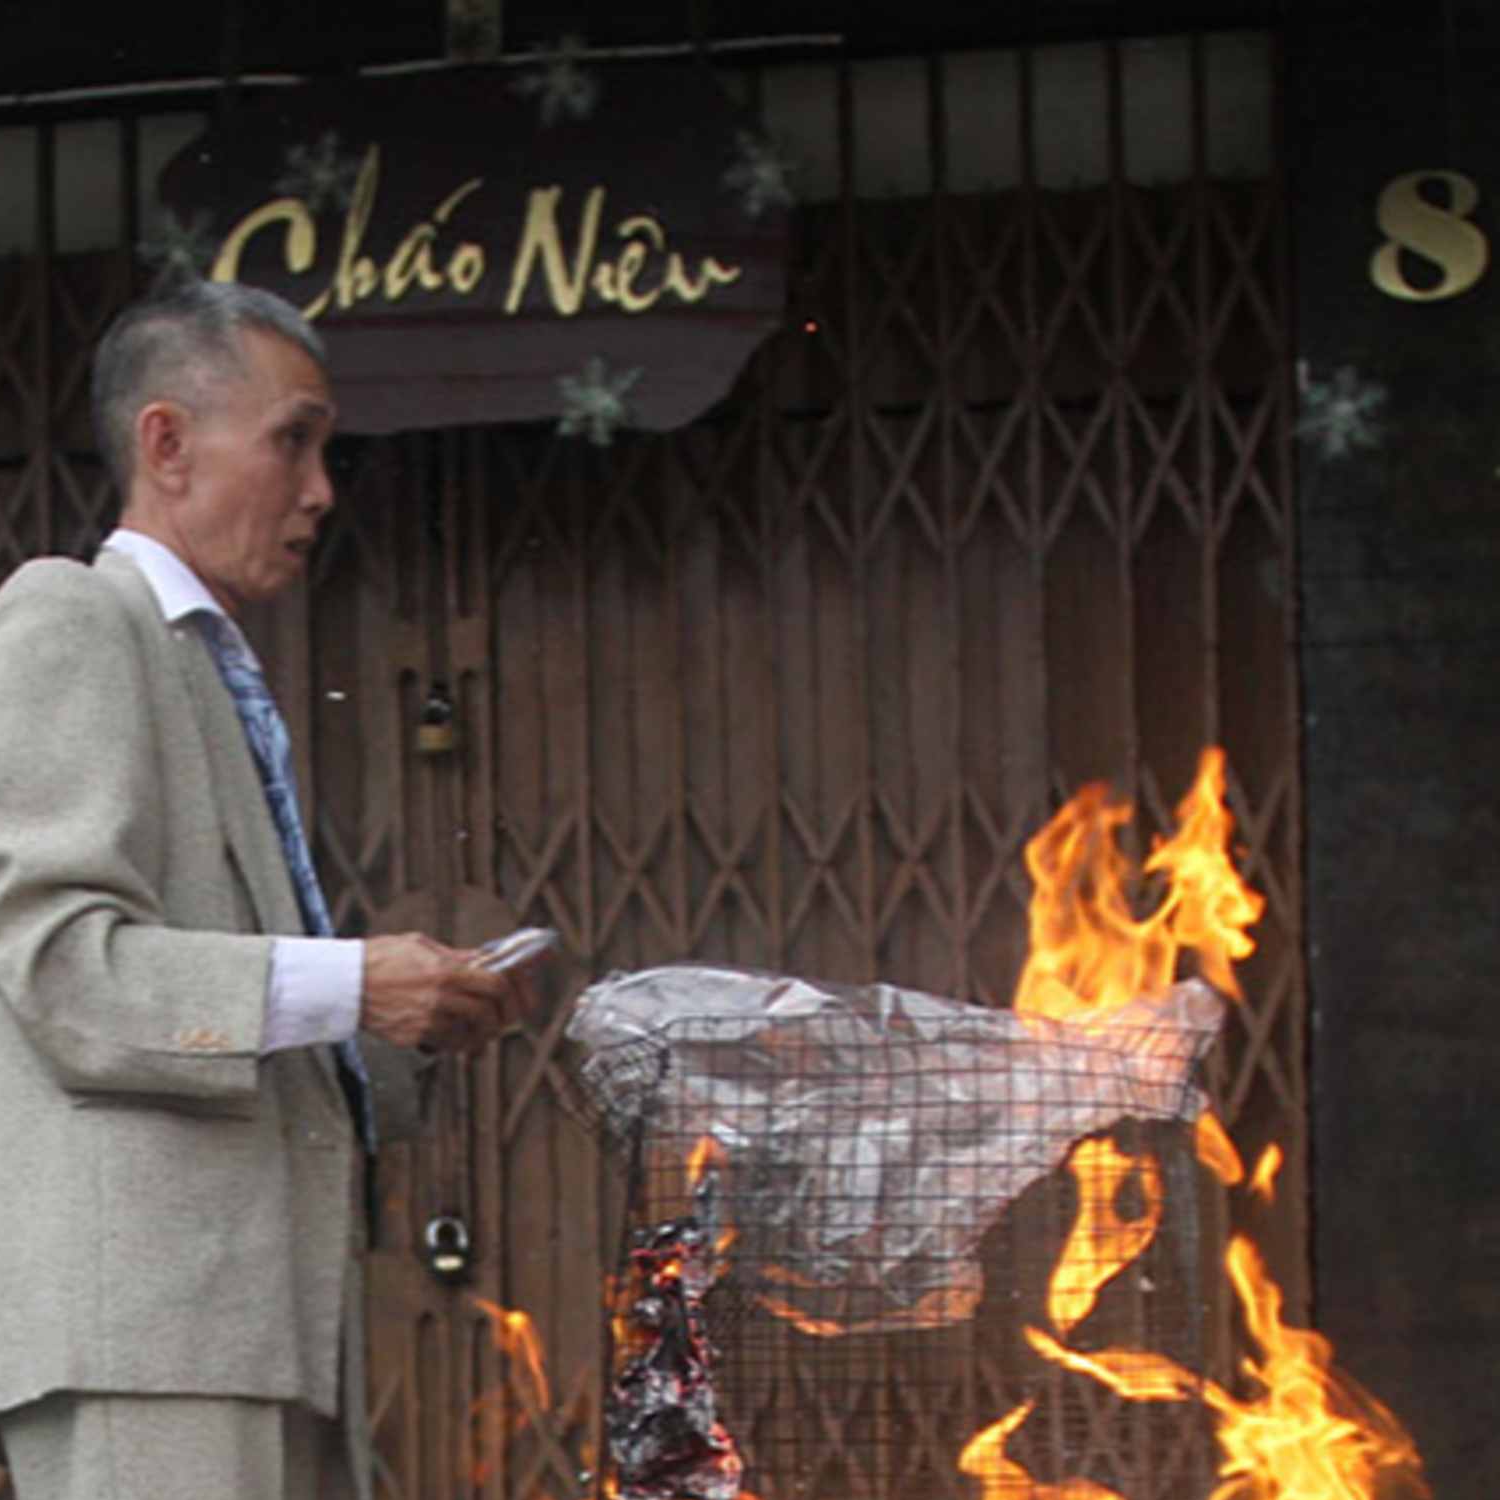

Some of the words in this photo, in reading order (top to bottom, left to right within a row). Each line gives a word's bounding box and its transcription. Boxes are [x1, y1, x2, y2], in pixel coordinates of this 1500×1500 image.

[211, 144, 484, 320] Cháo
[505, 186, 741, 315] Niêu
[1369, 169, 1489, 301] 8
